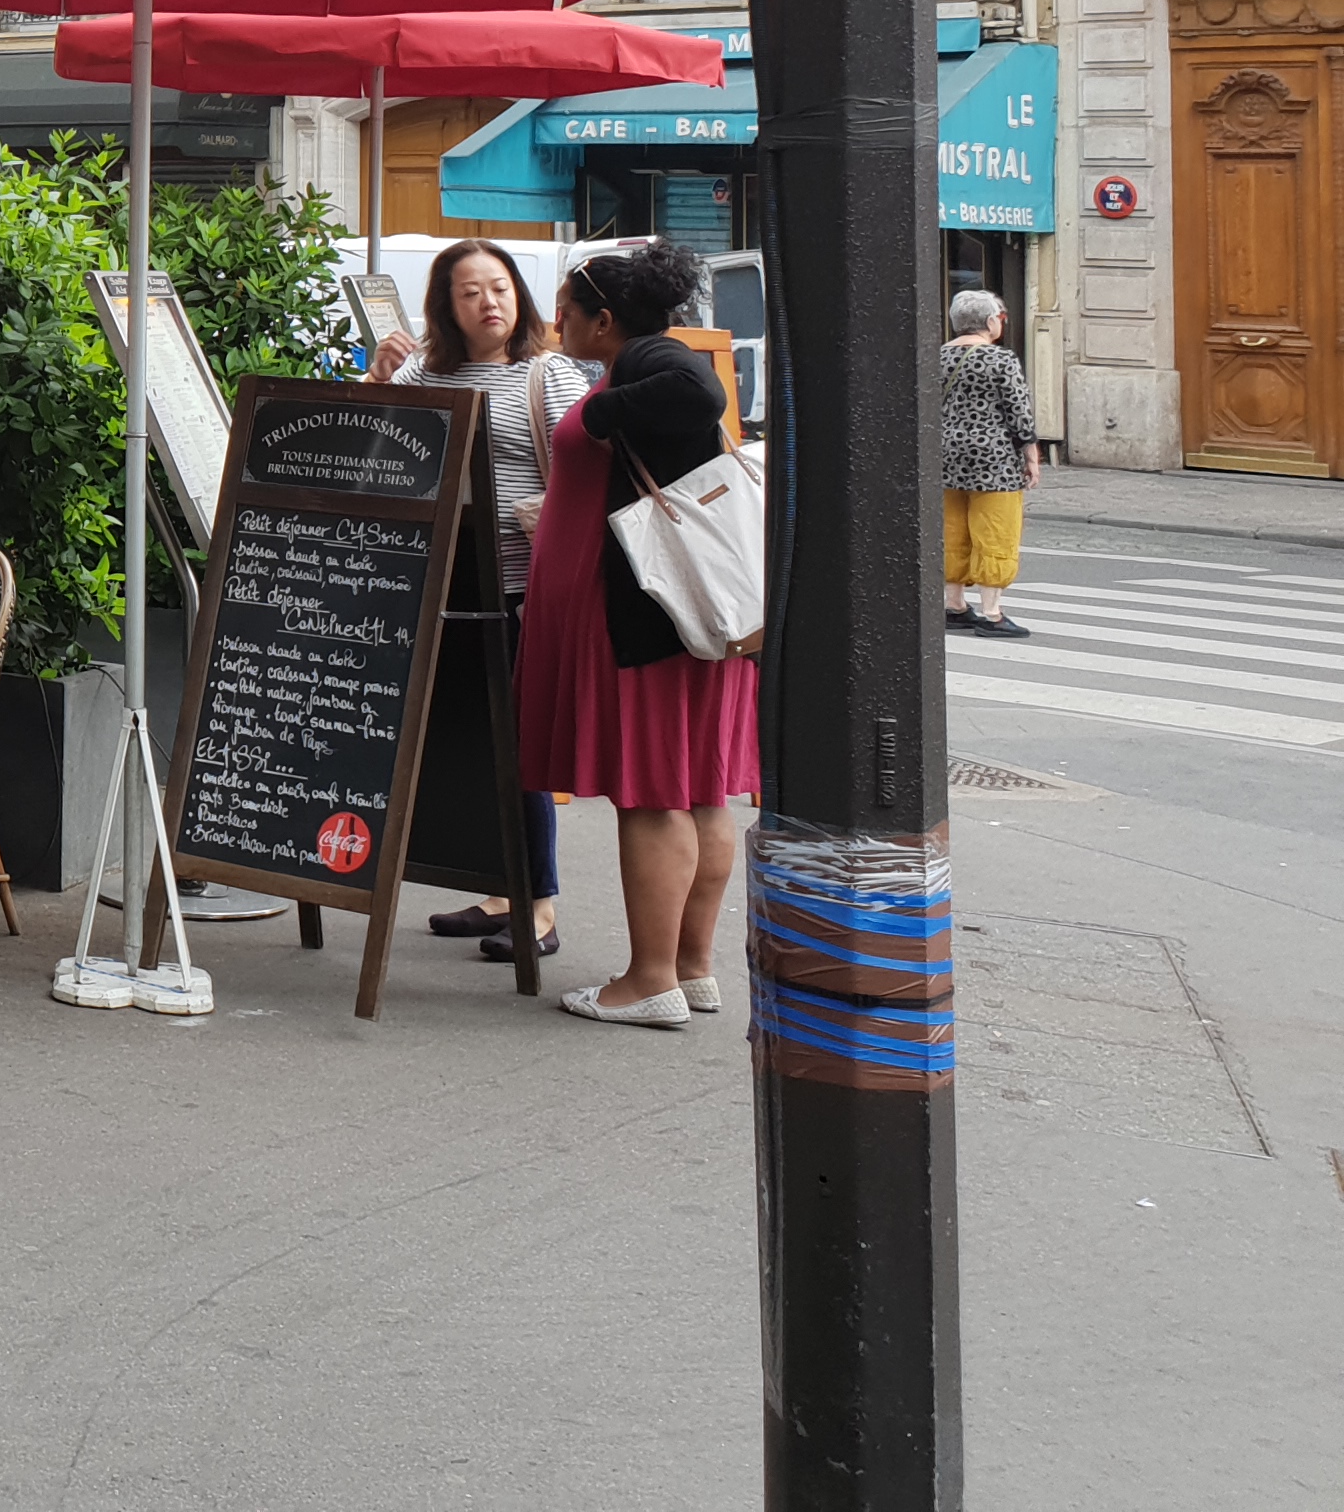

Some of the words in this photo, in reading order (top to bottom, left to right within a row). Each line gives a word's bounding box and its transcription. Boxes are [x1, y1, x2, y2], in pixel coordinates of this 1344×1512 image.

[1007, 94, 1035, 128] LE
[565, 119, 628, 139] CAFE
[675, 117, 728, 139] BAR
[960, 201, 1034, 226] BRASSERIE
[262, 412, 334, 448] TRIADOU
[337, 412, 432, 462] HAUSSMANN
[282, 450, 312, 463] TOUS
[314, 453, 332, 465] LES
[334, 455, 405, 471] DIMANCHES
[267, 463, 314, 478] BRUNCH
[316, 467, 331, 479] DE
[333, 469, 364, 482] 9H00
[365, 469, 374, 483] À
[378, 473, 416, 487] 15H30
[238, 510, 272, 532] Petit
[225, 576, 261, 601] Petit
[328, 573, 365, 595] orange
[279, 725, 296, 744] de
